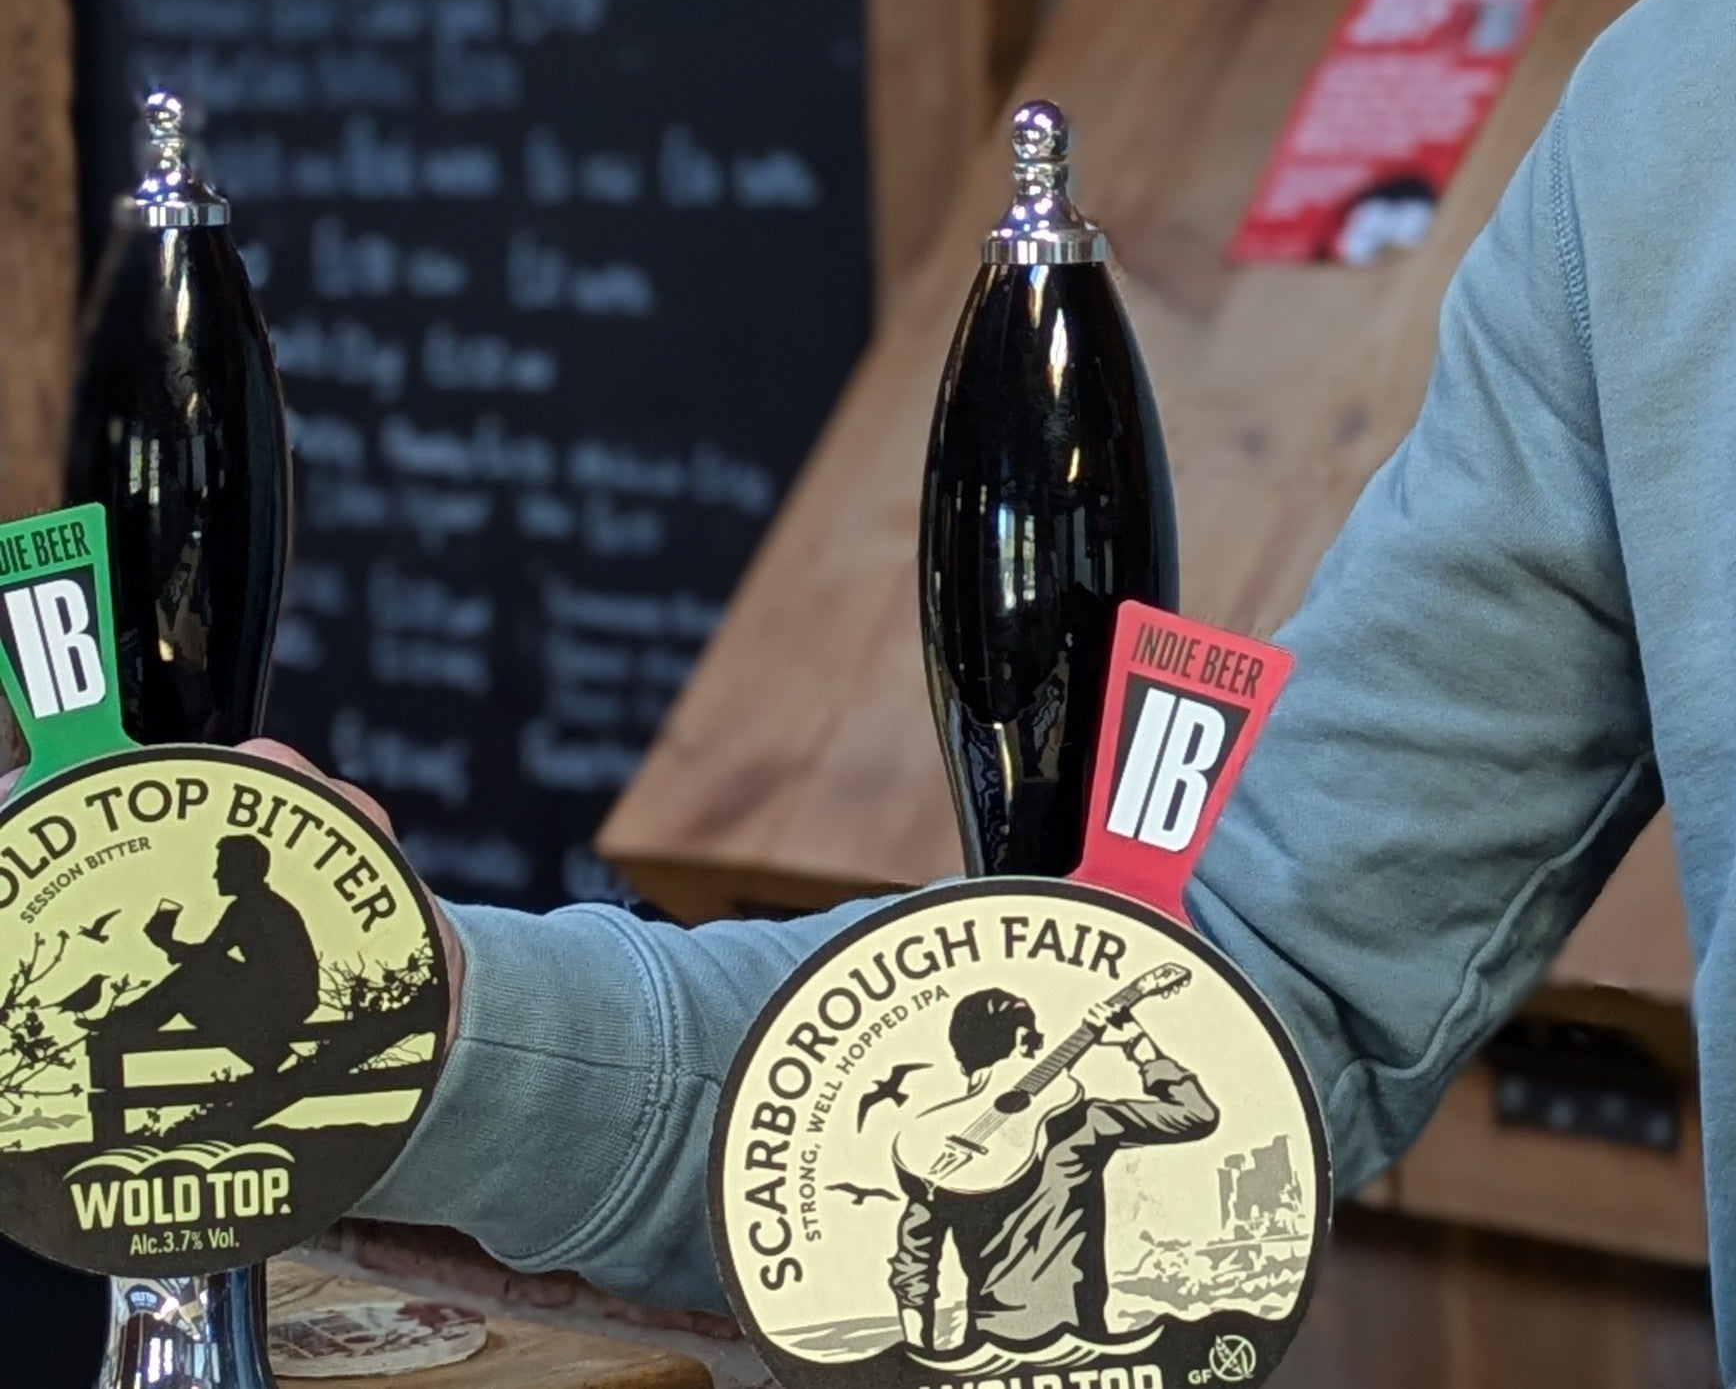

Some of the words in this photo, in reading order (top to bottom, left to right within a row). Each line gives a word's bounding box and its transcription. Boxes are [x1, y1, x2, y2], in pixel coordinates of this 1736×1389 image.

[31, 521, 92, 567] BEER
[1131, 622, 1200, 680] INDIE
[1199, 641, 1266, 700] BEER
[20, 863, 84, 924] SESSION
[84, 836, 152, 871] BITTER
[84, 778, 209, 833] TOP
[226, 784, 398, 933] BITTER
[910, 984, 950, 1011] IPA
[834, 1003, 909, 1075] HOPPED
[744, 919, 981, 1291] SCARBOROUGH
[1000, 915, 1128, 981] FAIR
[806, 1078, 843, 1134] WELL
[70, 1174, 201, 1231] WOLD
[798, 1144, 823, 1243] STRONG,
[129, 1230, 204, 1256] Alc.3.7%
[207, 1225, 241, 1251] Vol.
[1187, 1368, 1213, 1386] GF
